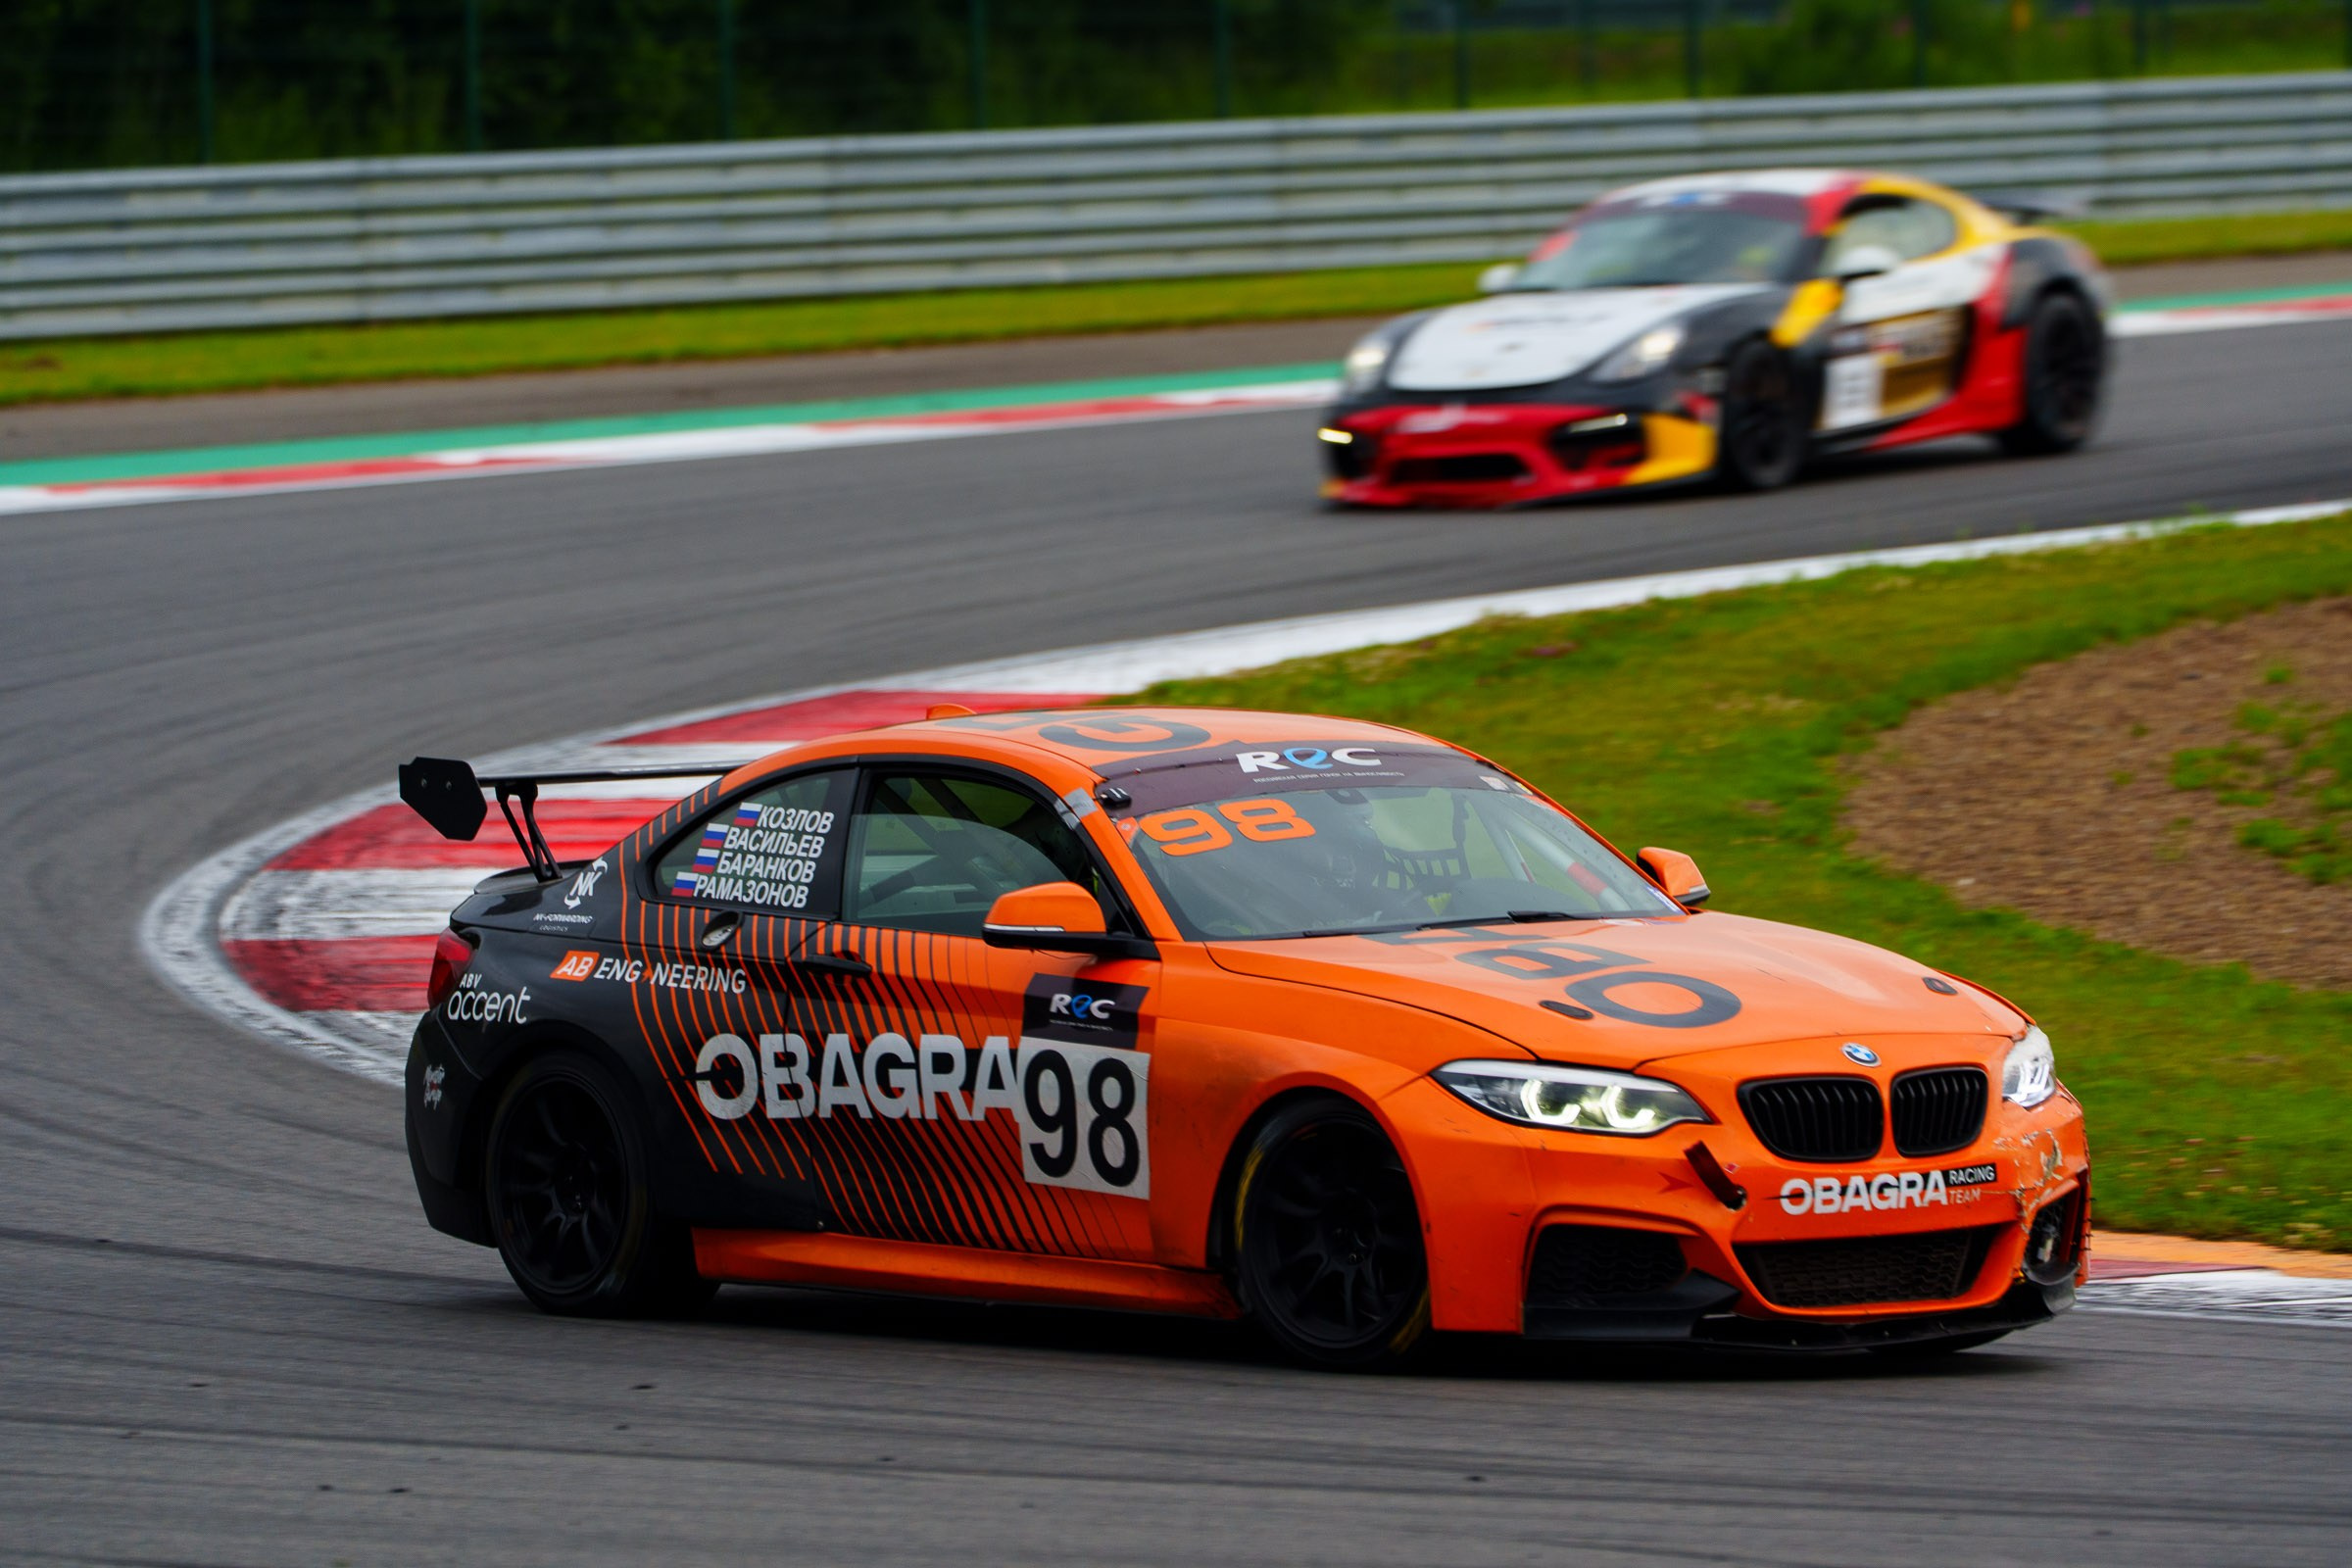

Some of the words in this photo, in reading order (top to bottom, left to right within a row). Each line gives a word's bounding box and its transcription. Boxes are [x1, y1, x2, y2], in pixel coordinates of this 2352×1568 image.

[757, 806, 835, 834] КОЗЛОВ
[1139, 799, 1316, 857] 98
[723, 826, 825, 858] ВАСИЛЬЕВ
[716, 851, 816, 883] БАРАНКОВ
[569, 871, 603, 896] NK
[693, 874, 809, 908] РАМАЗОНОВ
[460, 973, 482, 989] ABV
[557, 956, 594, 977] AB
[447, 986, 531, 1024] accent
[696, 1032, 1022, 1123] OBAGRA
[1023, 1049, 1140, 1188] 98
[1780, 1169, 1947, 1215] OBAGRA
[1948, 1165, 1995, 1186] RACING
[1949, 1188, 1981, 1204] TEAM
